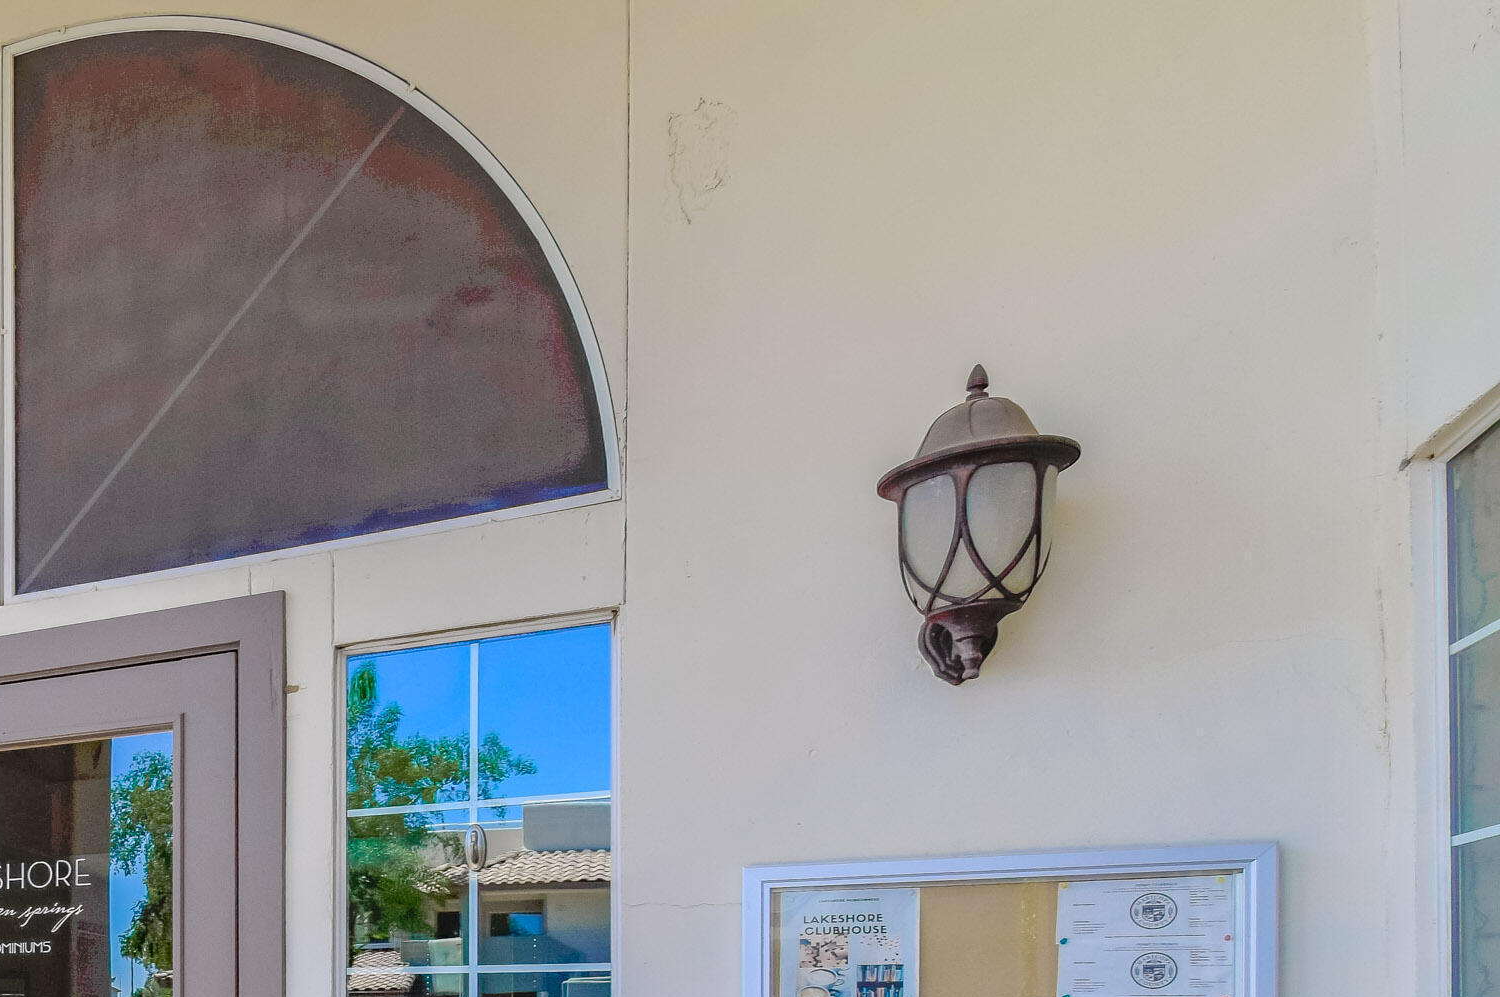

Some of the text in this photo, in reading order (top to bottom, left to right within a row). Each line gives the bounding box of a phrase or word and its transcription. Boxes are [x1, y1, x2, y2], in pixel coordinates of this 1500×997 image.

[18, 902, 84, 932] springs
[804, 914, 883, 924] LAKESHORE
[804, 926, 887, 936] CLUBHOUSE
